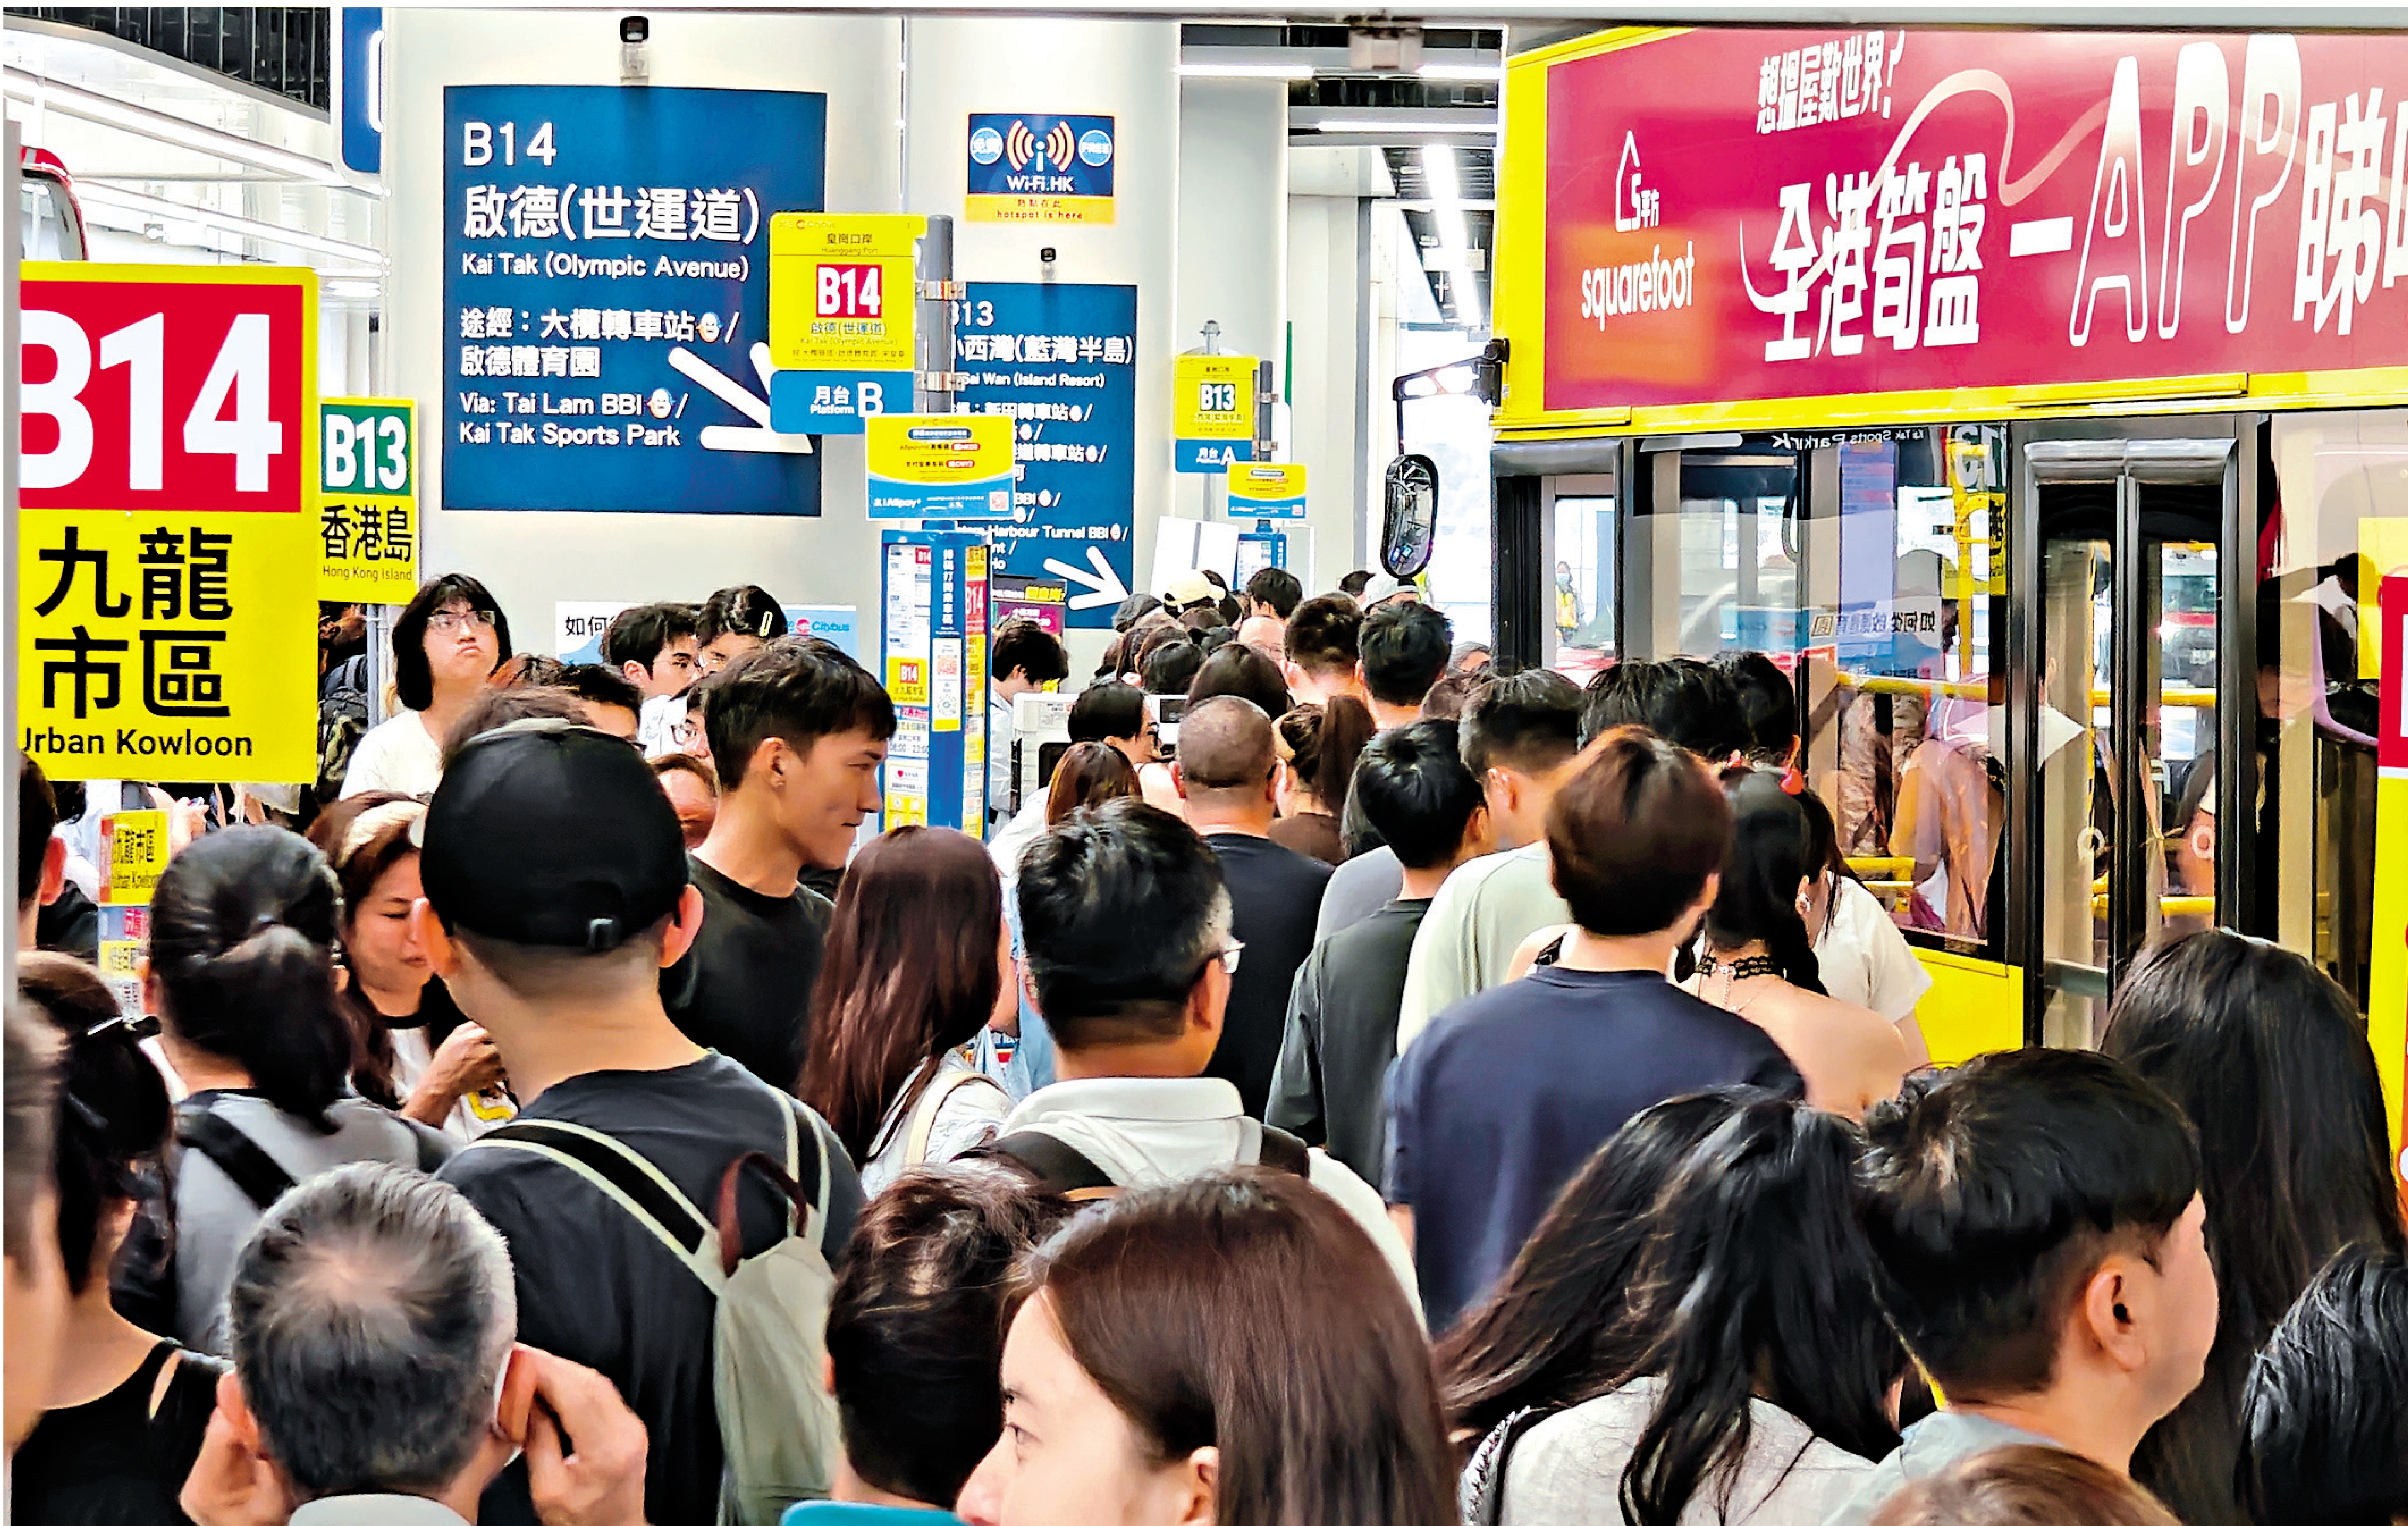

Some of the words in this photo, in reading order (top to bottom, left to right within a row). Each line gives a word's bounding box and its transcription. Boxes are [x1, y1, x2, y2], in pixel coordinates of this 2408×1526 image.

[463, 122, 557, 166] B14
[2070, 33, 2302, 347] APP
[465, 183, 759, 245] 啟德(世運道)
[997, 210, 1039, 219] hotspot
[1059, 211, 1082, 219] here
[822, 248, 861, 257] Huanggang
[462, 253, 493, 275] Kai
[500, 253, 538, 275] Tak
[546, 251, 646, 280] (Olympic
[654, 255, 750, 282] Avenue)
[818, 267, 881, 315] B14
[1581, 241, 1695, 332] squarefoot
[460, 345, 601, 377] 啟德體育園
[982, 372, 1011, 386] Wan
[1014, 371, 1056, 387] (Island
[20, 310, 282, 492] B14
[460, 392, 496, 414] Via:
[503, 392, 536, 414] Tai
[542, 393, 594, 415] Lam
[602, 393, 642, 415] BBI
[814, 386, 850, 405] 月台
[858, 382, 883, 417] B
[1201, 385, 1235, 410] B13
[810, 405, 854, 414] Platform
[460, 423, 491, 444] Kai
[496, 423, 536, 445] Tak
[542, 425, 620, 448] Sports
[627, 426, 681, 447] Park
[326, 414, 407, 490] B13
[1220, 446, 1237, 465] A
[321, 504, 413, 562] 香港島
[988, 525, 1039, 538] Harbour
[1042, 525, 1086, 538] Tunnel
[1089, 526, 1108, 539] BBI
[34, 526, 233, 621] 九龍
[323, 565, 349, 581] Hong
[353, 566, 378, 583] Kong
[382, 568, 412, 581] Island
[566, 616, 616, 636] 如何
[811, 621, 850, 632] Citybus
[34, 626, 232, 719] 市區
[901, 664, 918, 681] B14
[117, 728, 252, 757] Kowloon
